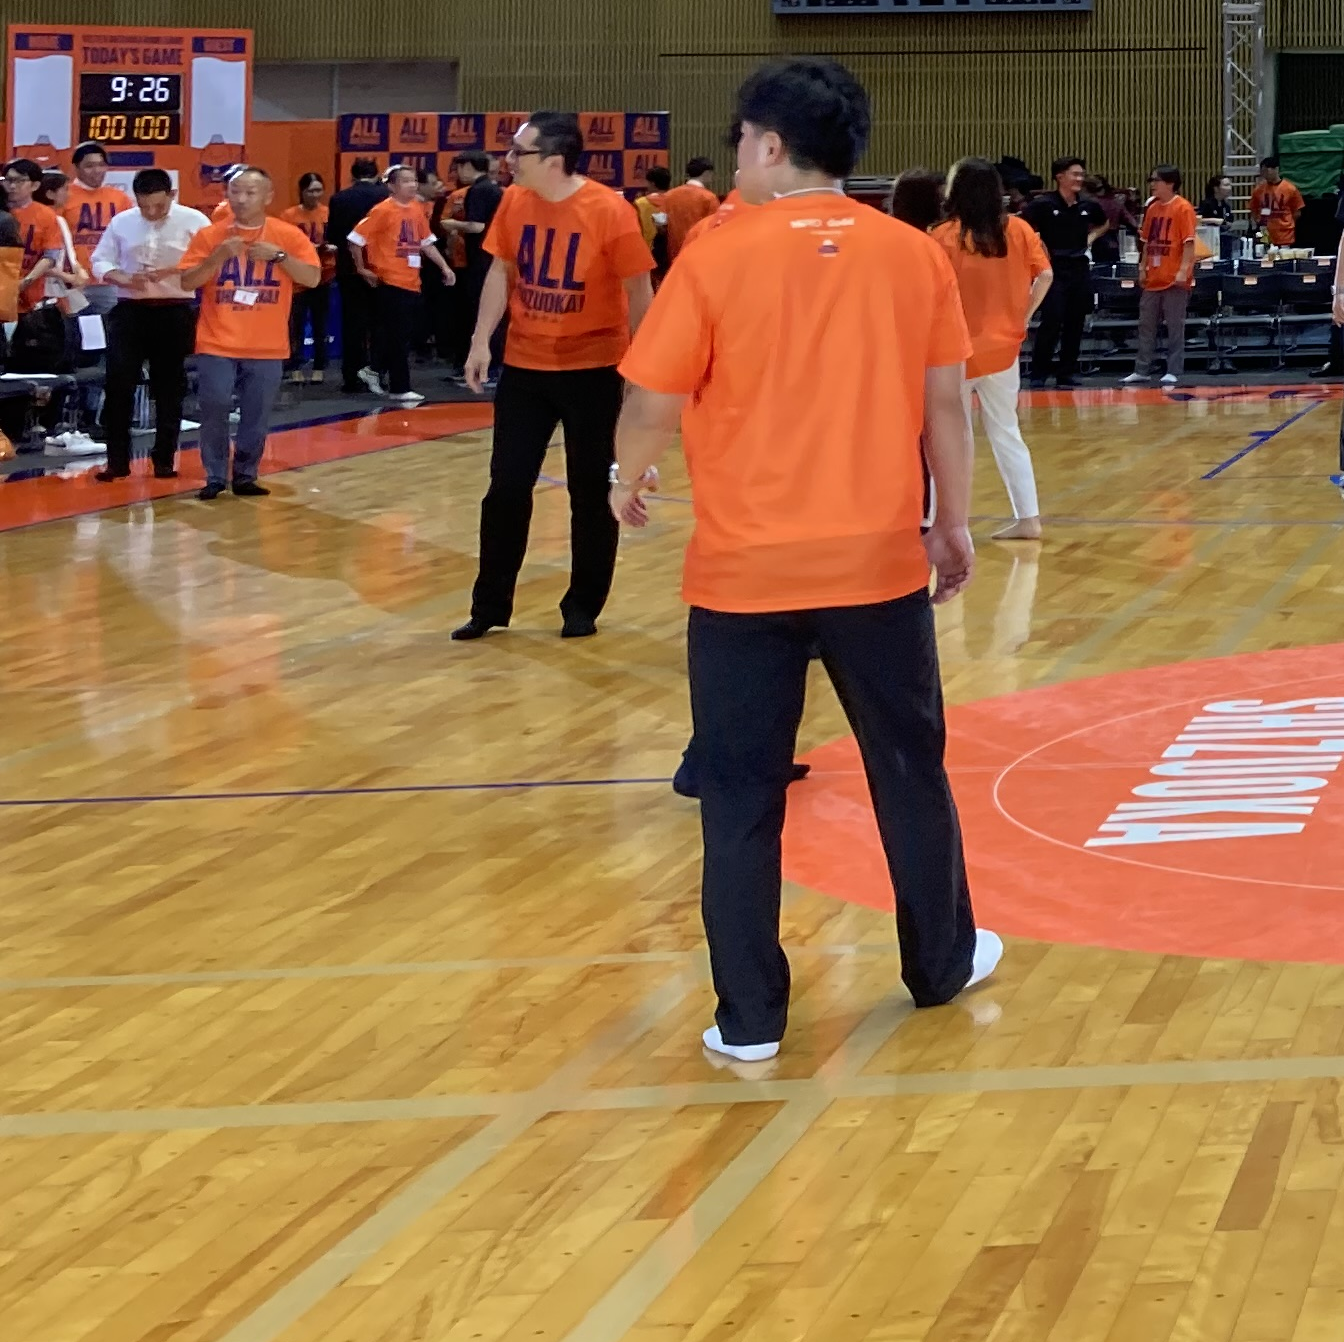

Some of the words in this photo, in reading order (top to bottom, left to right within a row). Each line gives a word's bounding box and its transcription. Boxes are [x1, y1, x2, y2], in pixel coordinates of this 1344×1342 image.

[111, 76, 170, 102] 9:26
[89, 114, 127, 140] 100
[133, 115, 170, 140] 100
[516, 225, 586, 291] ALL
